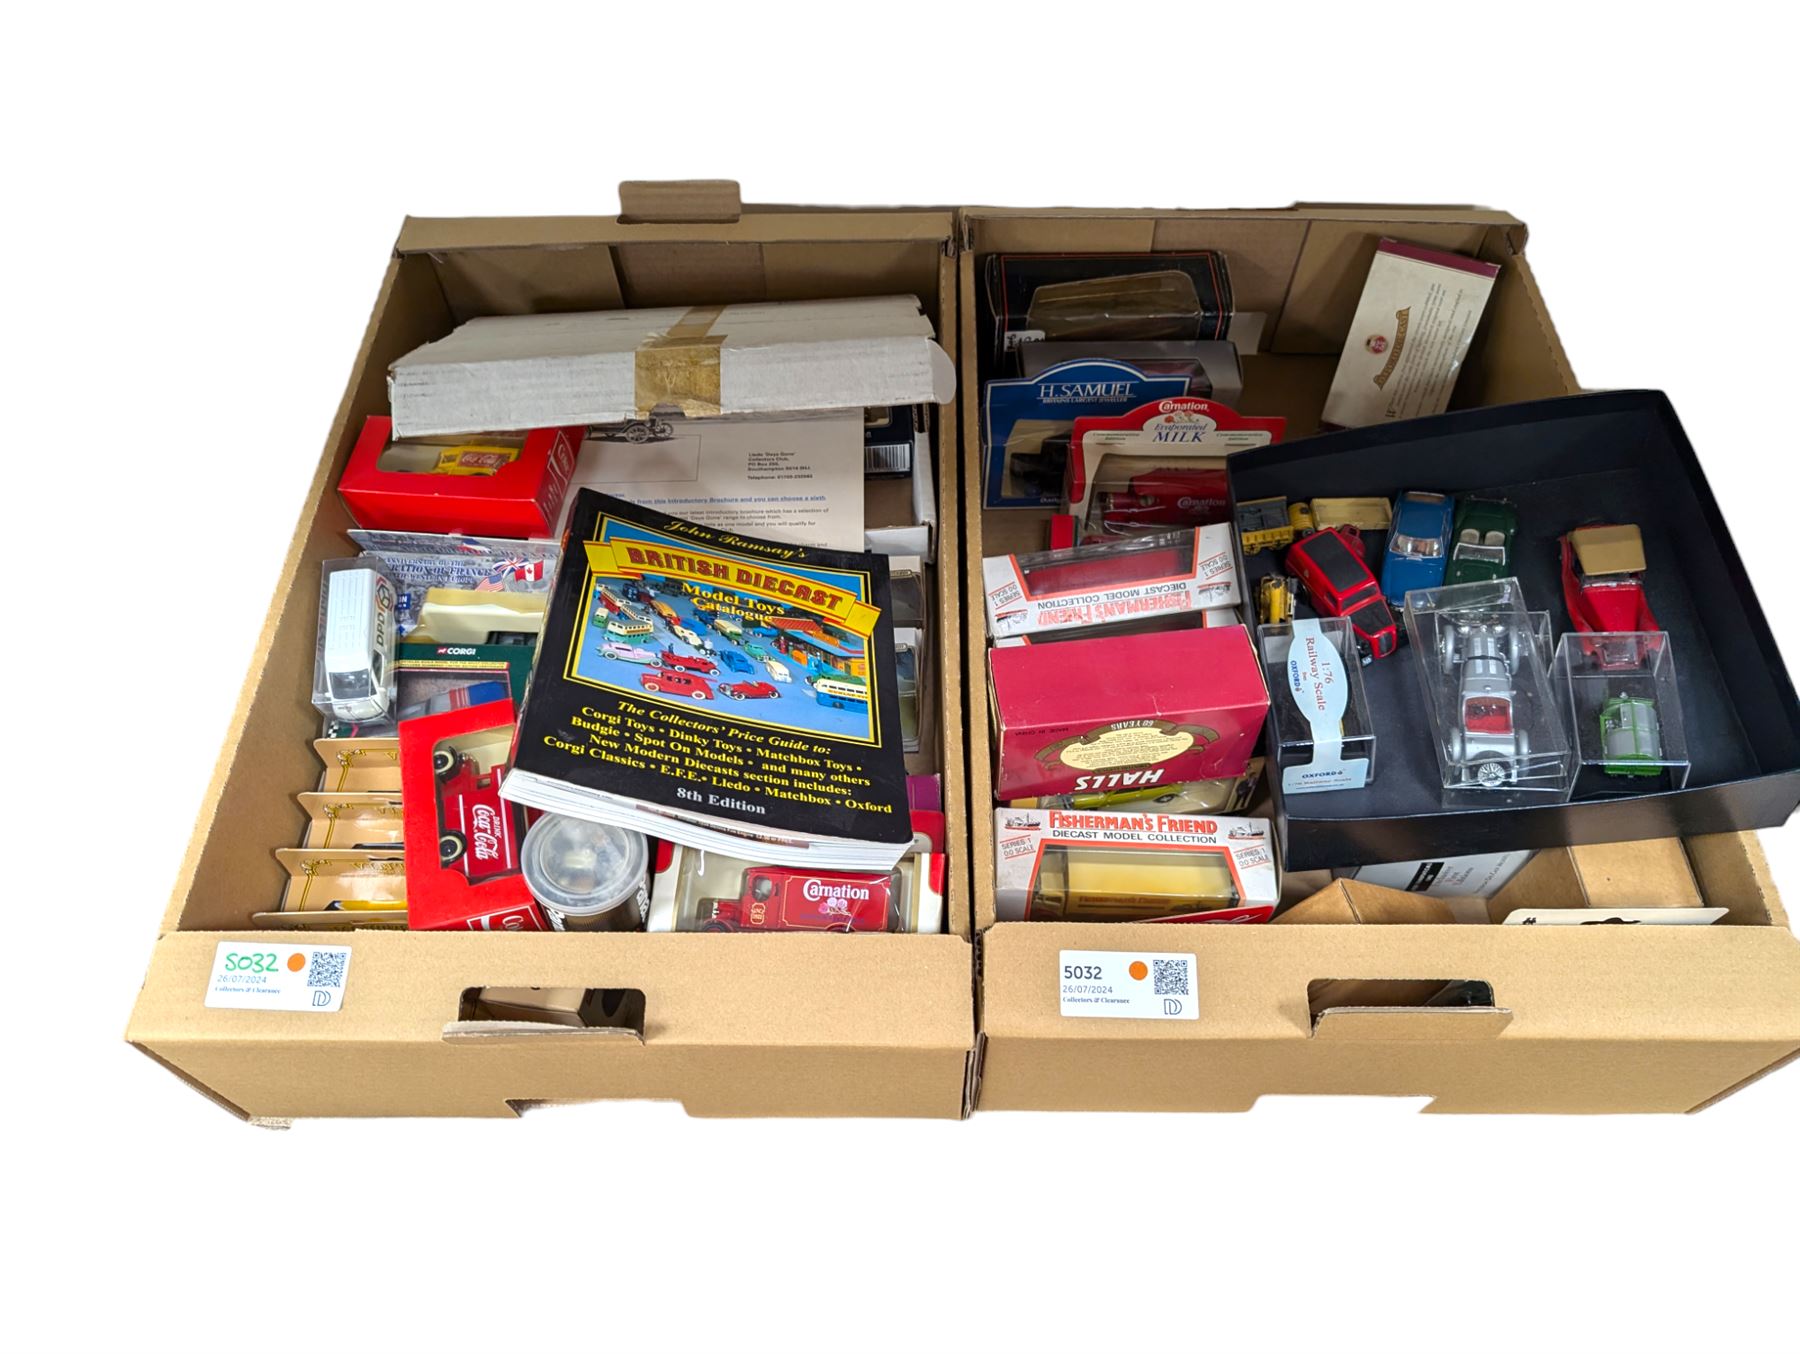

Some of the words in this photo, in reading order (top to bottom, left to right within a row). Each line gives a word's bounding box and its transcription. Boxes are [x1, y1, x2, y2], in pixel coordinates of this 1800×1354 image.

[1158, 400, 1210, 414] Carnation
[1152, 432, 1206, 443] MILK
[1154, 424, 1208, 434] Evaporated
[664, 520, 715, 540] John
[719, 534, 810, 559] Ramsay's
[626, 547, 731, 582] BRITISH
[736, 568, 843, 610] DIECAST
[1144, 582, 1186, 596] DIECAST
[682, 582, 740, 606] Model
[744, 596, 785, 616] Toys
[1038, 594, 1100, 608] COLLECTION
[1102, 588, 1140, 600] MODEL
[692, 596, 773, 624] Catalogue
[376, 612, 386, 648] DPD
[447, 647, 476, 656] CORGI
[1290, 660, 1300, 688] OXFORD
[1306, 637, 1319, 680] Railway
[1314, 682, 1326, 711] Scale
[618, 701, 646, 716] The
[728, 727, 764, 744] Price
[768, 736, 810, 752] Guide
[812, 744, 832, 755] to:
[570, 716, 621, 738] Budgie
[634, 732, 667, 751] Spot
[670, 740, 692, 754] On
[694, 746, 744, 768] Models
[761, 760, 787, 774] and
[790, 769, 827, 786] many
[830, 773, 871, 788] others
[581, 706, 622, 725] Corgi
[624, 716, 656, 734] Toys
[668, 728, 710, 746] Dinky
[712, 737, 743, 754] Toys
[756, 746, 822, 769] Matchbox
[824, 758, 854, 776] Toys
[542, 735, 586, 757] Corgi
[588, 747, 646, 770] Classics
[711, 774, 751, 792] Lledo
[764, 786, 832, 807] Matchbox
[844, 798, 893, 815] Oxford
[588, 734, 622, 750] New
[624, 741, 682, 766] Modern
[684, 754, 740, 778] Diecasts
[742, 769, 790, 788] section
[793, 776, 852, 796] includes:
[1302, 771, 1337, 779] OXFORD
[1074, 768, 1165, 791] HALLS
[676, 786, 704, 803] 8th
[707, 792, 766, 815] Edition
[472, 804, 499, 860] Coca-Cola
[494, 816, 502, 838] DRINK
[1049, 810, 1154, 832] FISHERMAN'S
[1157, 815, 1218, 834] FRIEND
[1001, 838, 1025, 850] SERIES
[1052, 830, 1099, 840] DIECAST
[1103, 832, 1143, 841] MODEL
[1147, 834, 1217, 844] COLLECTION
[1236, 849, 1260, 860] SERIES
[802, 878, 870, 901] Carnation
[217, 974, 267, 984] 26/07/2024
[1064, 966, 1102, 980] 5032
[1062, 984, 1113, 994] 26/07/2024
